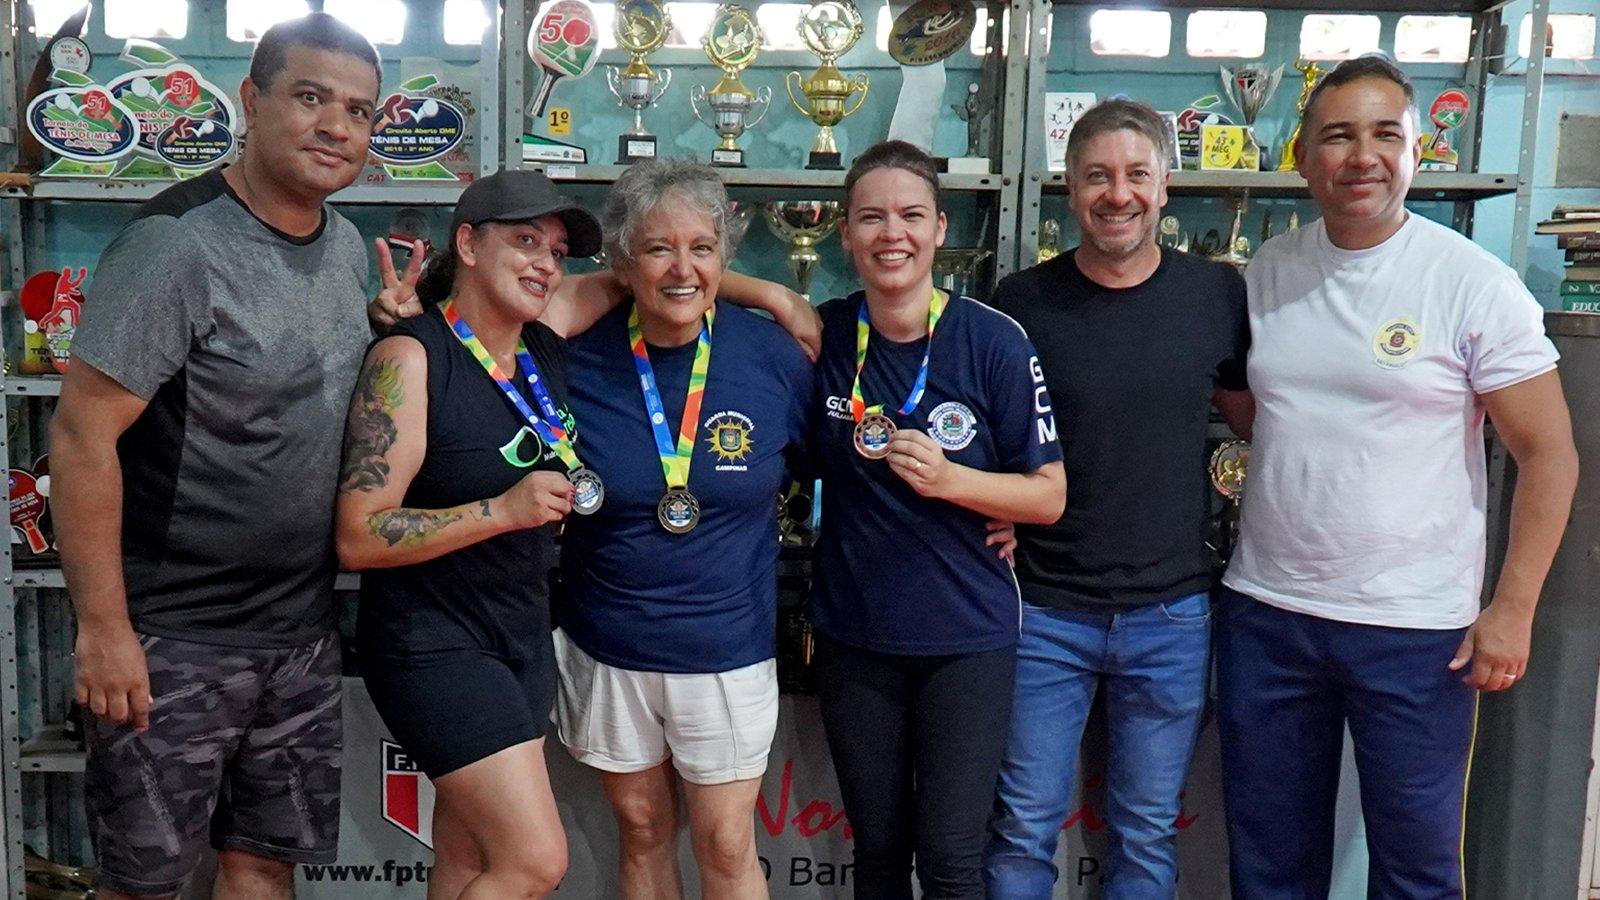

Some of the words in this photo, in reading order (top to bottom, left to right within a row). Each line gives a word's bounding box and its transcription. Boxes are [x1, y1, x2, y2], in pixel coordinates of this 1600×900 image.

[171, 77, 194, 95] 51
[87, 96, 107, 109] 51
[48, 128, 77, 139] TÊNIS
[93, 132, 121, 141] MESA
[371, 134, 399, 144] TÊNIS
[402, 136, 416, 144] DE
[419, 136, 449, 144] MESA
[1029, 355, 1057, 445] GCM
[789, 857, 855, 887] Bar
